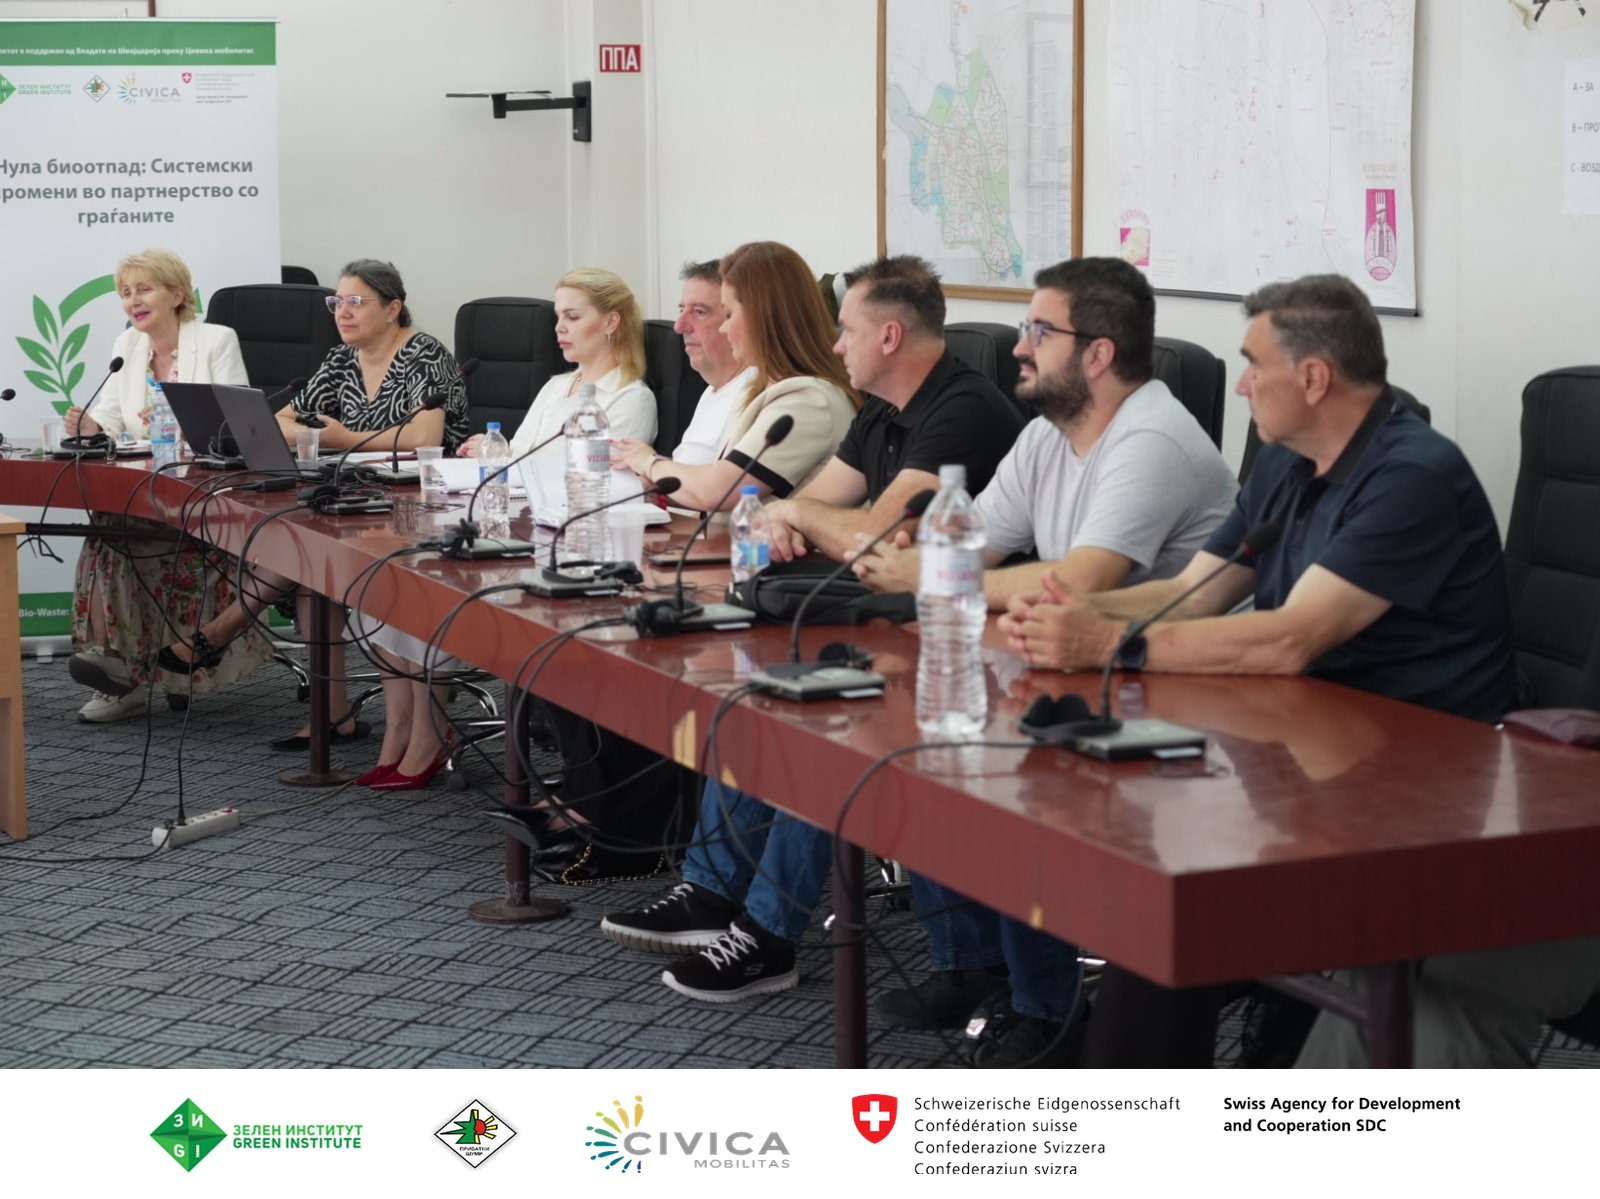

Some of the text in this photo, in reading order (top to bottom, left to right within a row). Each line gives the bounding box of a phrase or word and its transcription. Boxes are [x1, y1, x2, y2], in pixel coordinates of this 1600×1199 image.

[76, 47, 107, 56] Владата
[162, 48, 184, 57] преку
[185, 47, 213, 56] Цивика
[601, 46, 638, 71] ППА
[129, 87, 181, 98] CIVICA
[47, 158, 147, 177] биоотпад:
[151, 158, 253, 174] Системски
[0, 186, 259, 204] ромени во партнерство со
[77, 208, 175, 228] граѓаните
